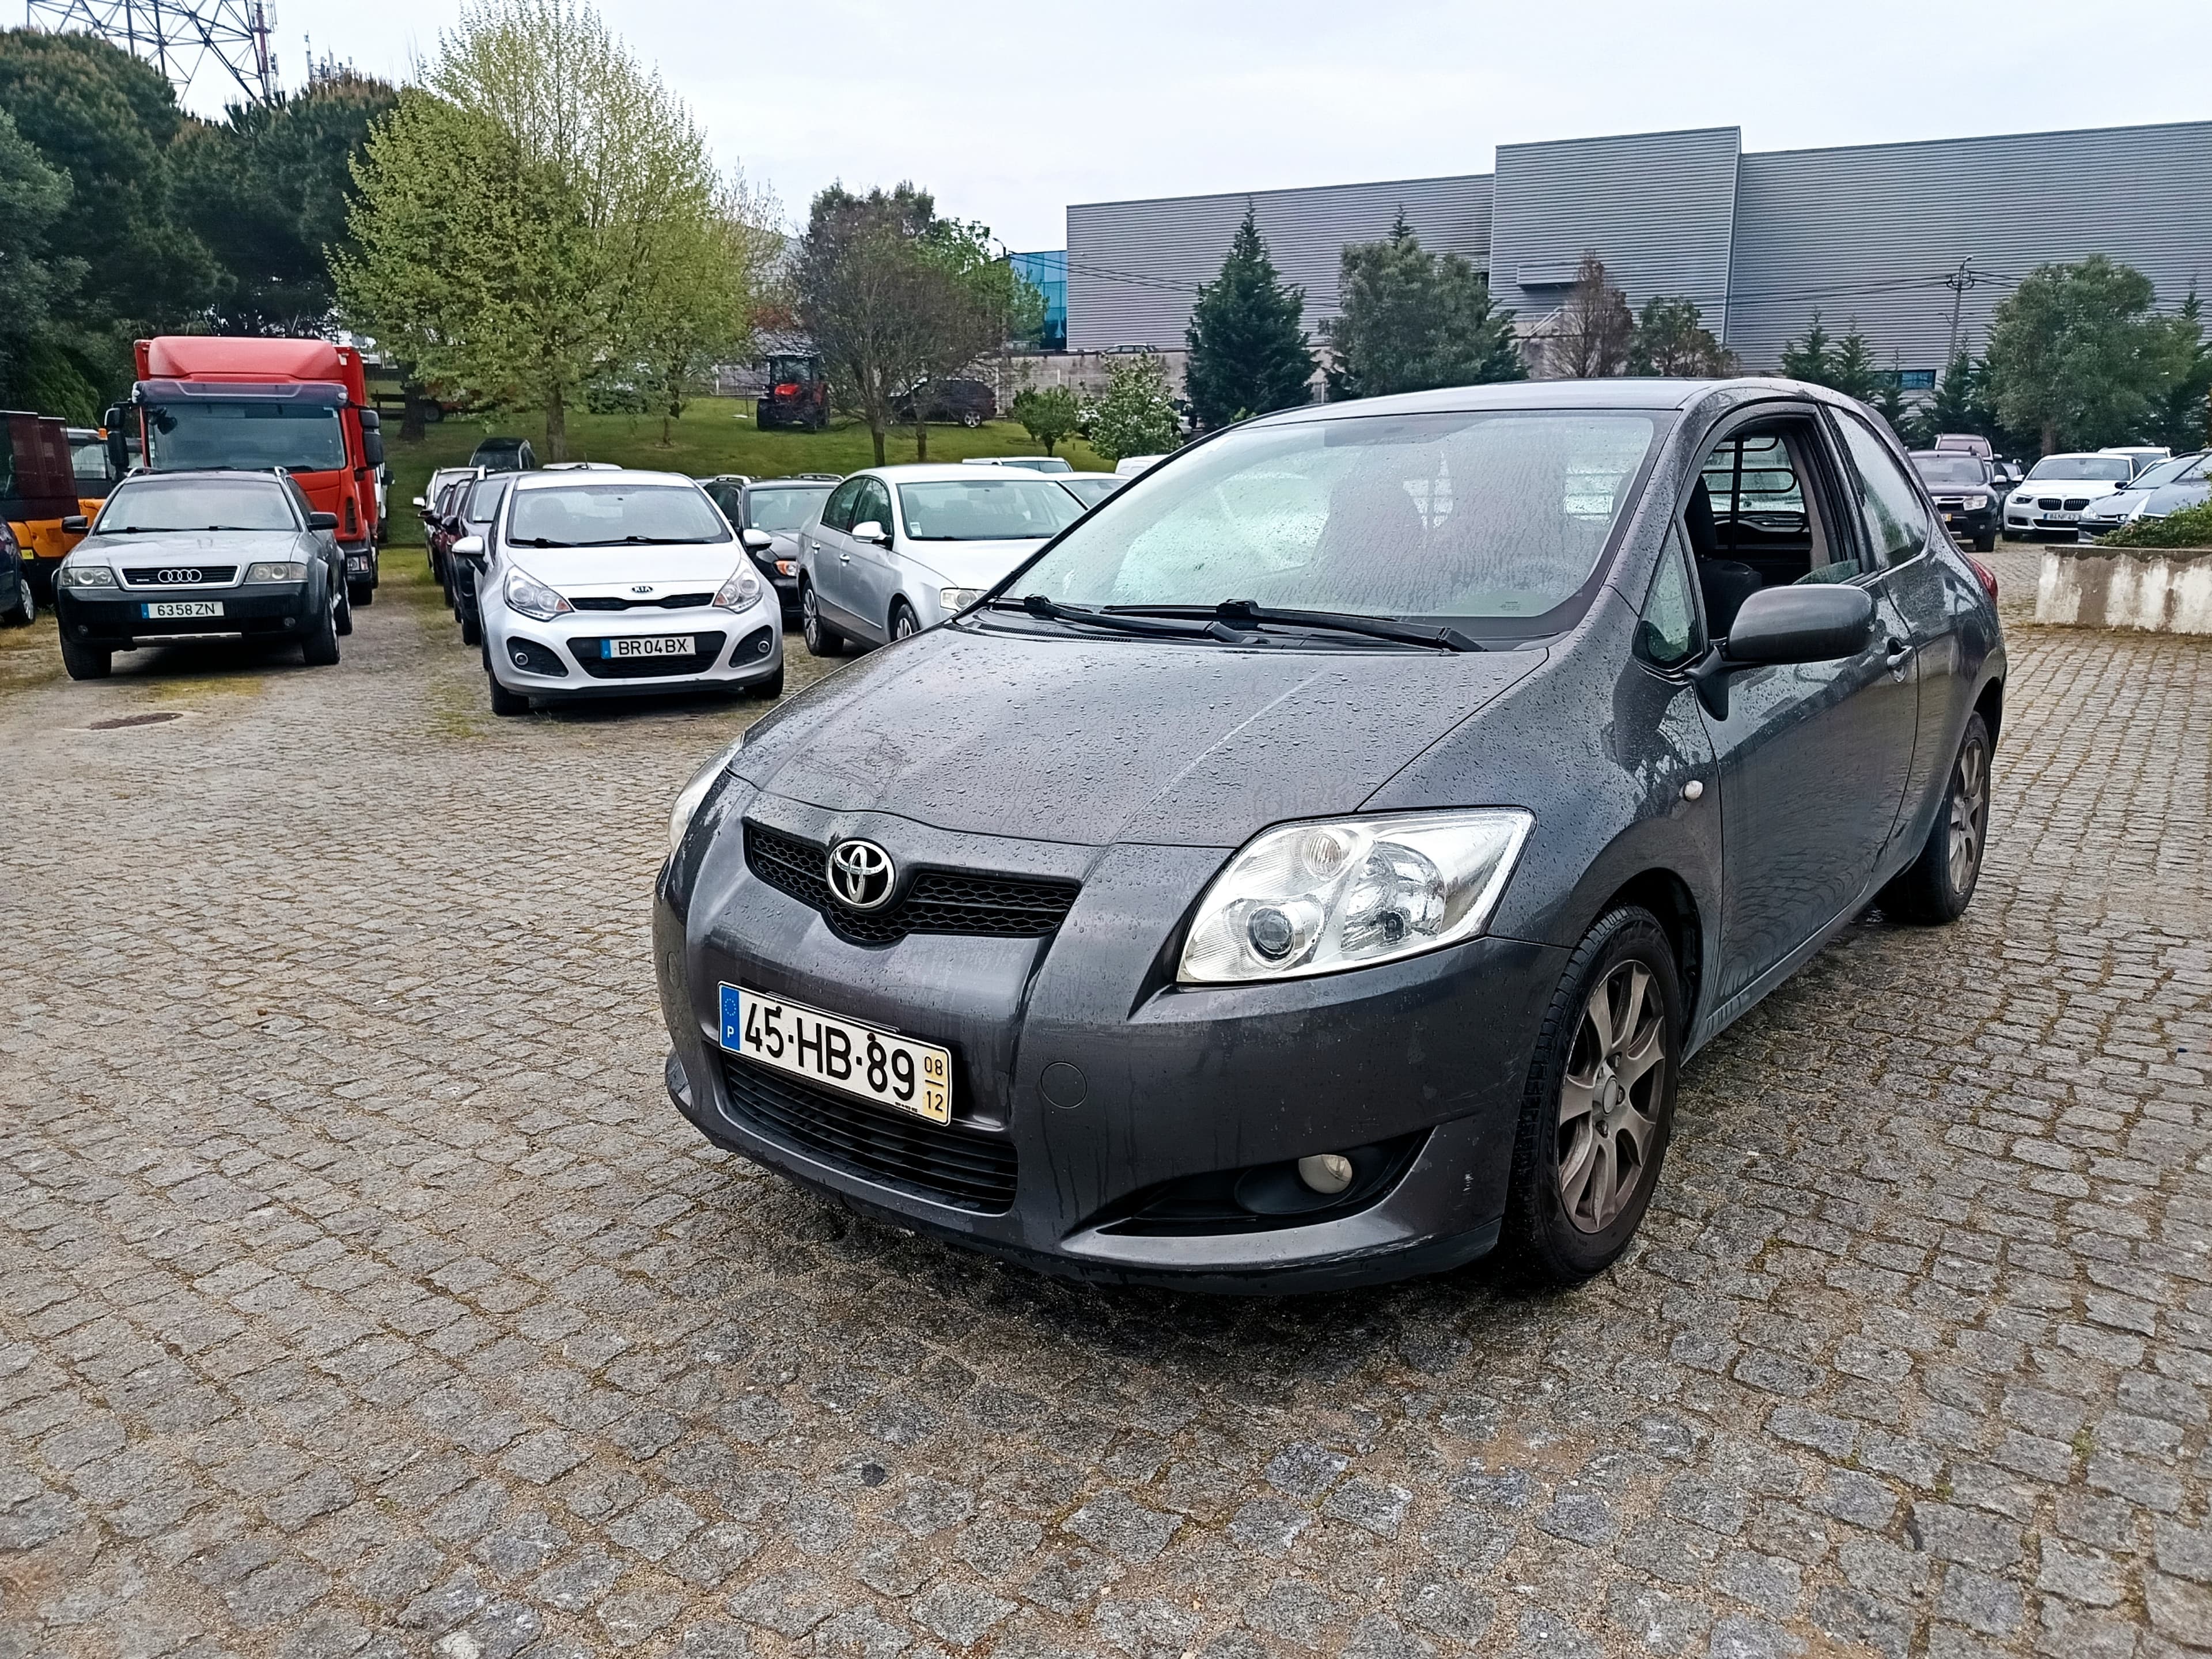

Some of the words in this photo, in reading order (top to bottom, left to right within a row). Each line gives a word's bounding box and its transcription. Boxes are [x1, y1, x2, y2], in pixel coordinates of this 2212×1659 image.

[727, 1025, 734, 1038] P
[925, 1056, 943, 1075] 08
[927, 1091, 944, 1112] 12
